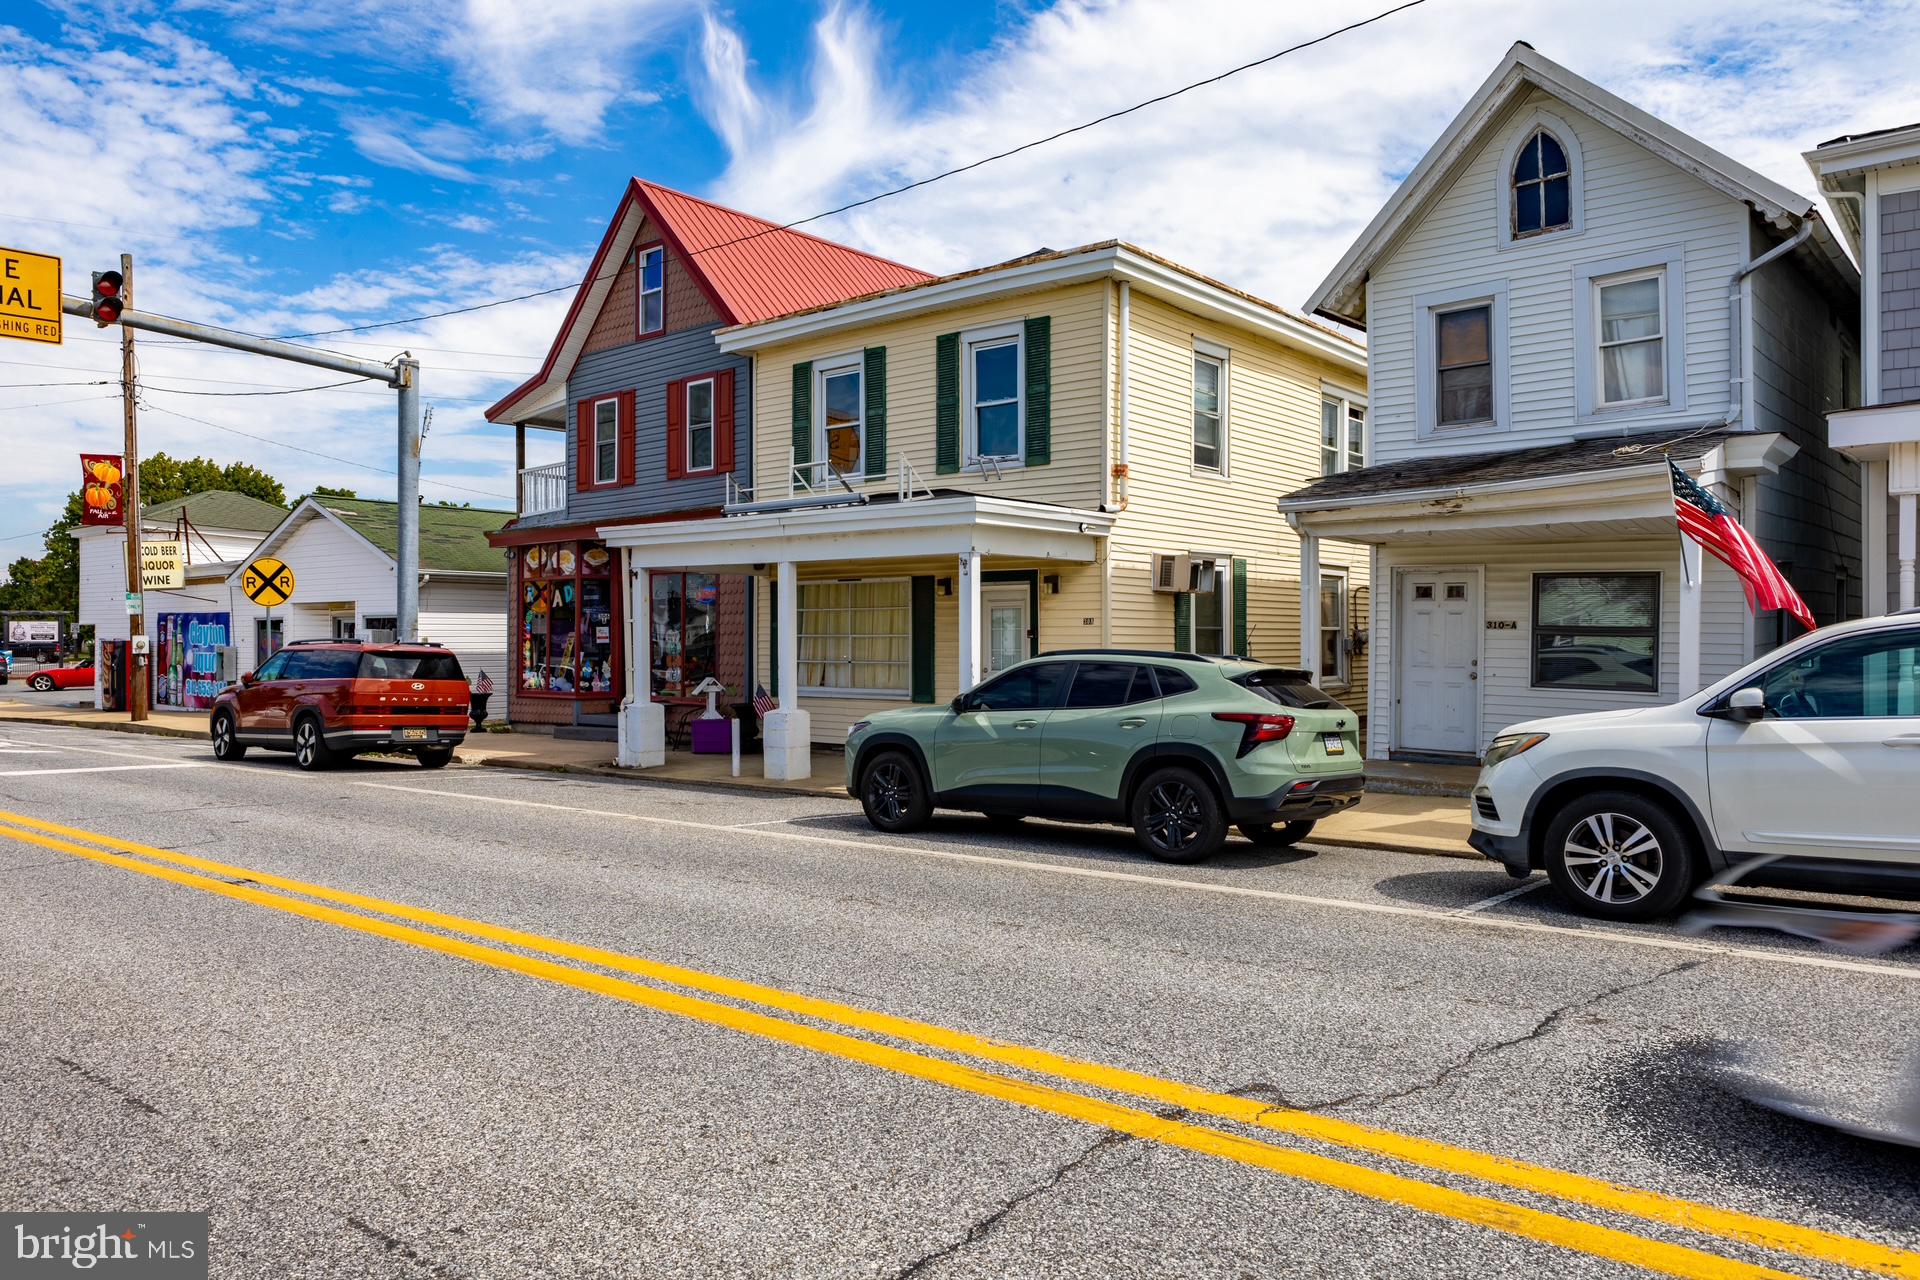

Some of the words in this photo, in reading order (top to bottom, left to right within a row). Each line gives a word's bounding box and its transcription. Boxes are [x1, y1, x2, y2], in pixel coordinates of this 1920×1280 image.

[0, 319, 29, 333] HING
[36, 324, 57, 337] RED
[161, 546, 177, 556] BEER
[143, 575, 171, 585] WINE
[1486, 621, 1517, 630] 310-A
[189, 620, 226, 647] Clayton
